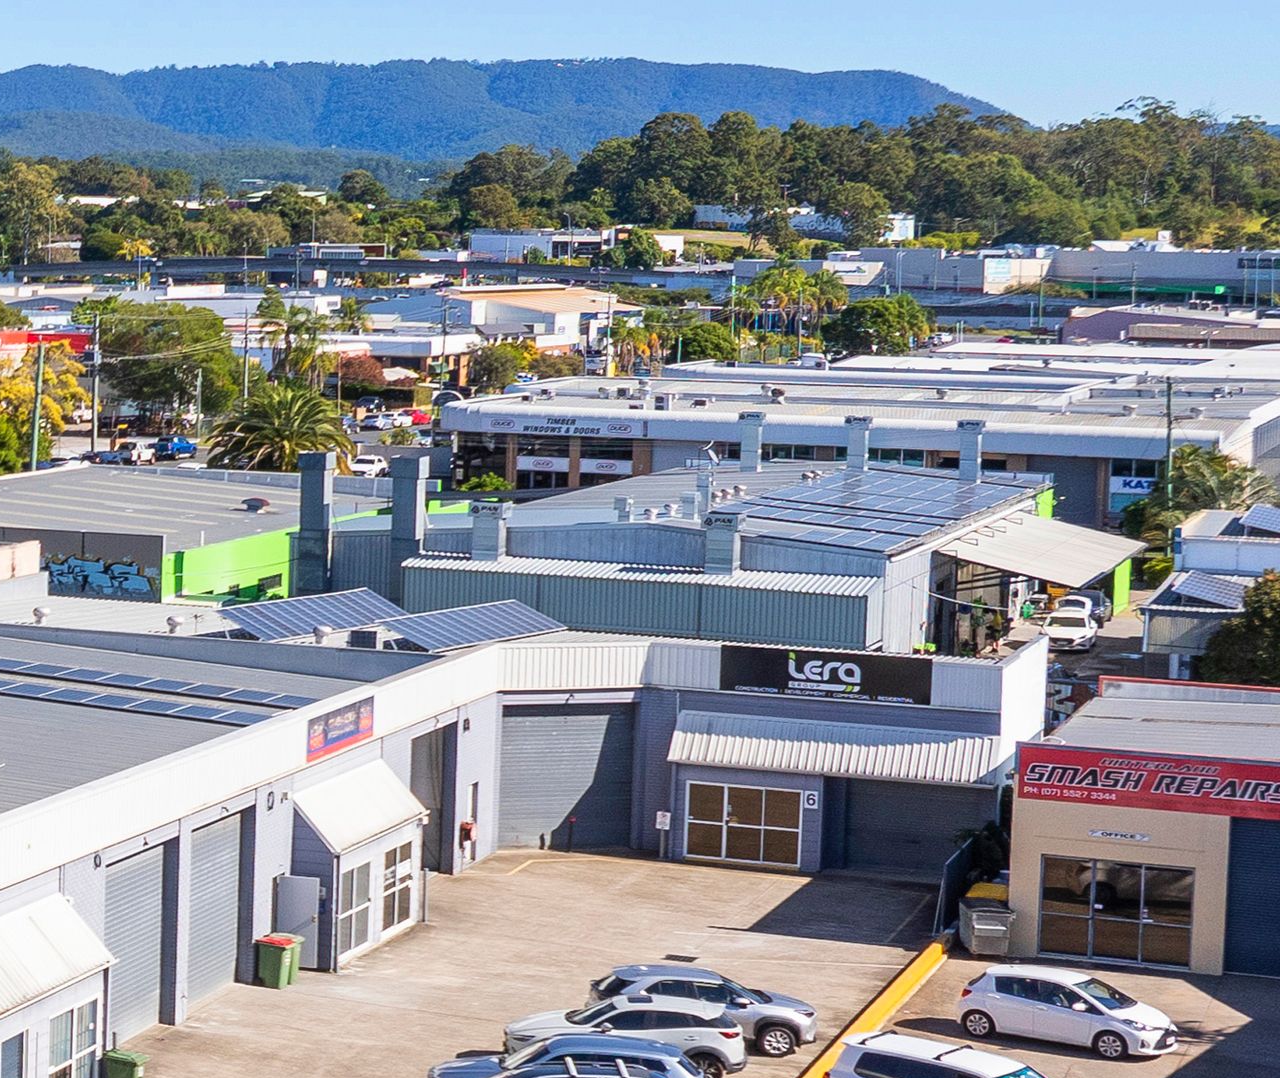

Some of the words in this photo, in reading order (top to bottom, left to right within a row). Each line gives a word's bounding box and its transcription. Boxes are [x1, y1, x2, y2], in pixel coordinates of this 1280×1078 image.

[545, 417, 577, 426] TIMBER
[522, 425, 562, 434] WINDOWS
[573, 426, 601, 435] DOORS
[1024, 762, 1147, 791] SMASH
[1041, 787, 1061, 797] (07)
[806, 793, 816, 806] 6
[1101, 831, 1137, 839] OFFICE
